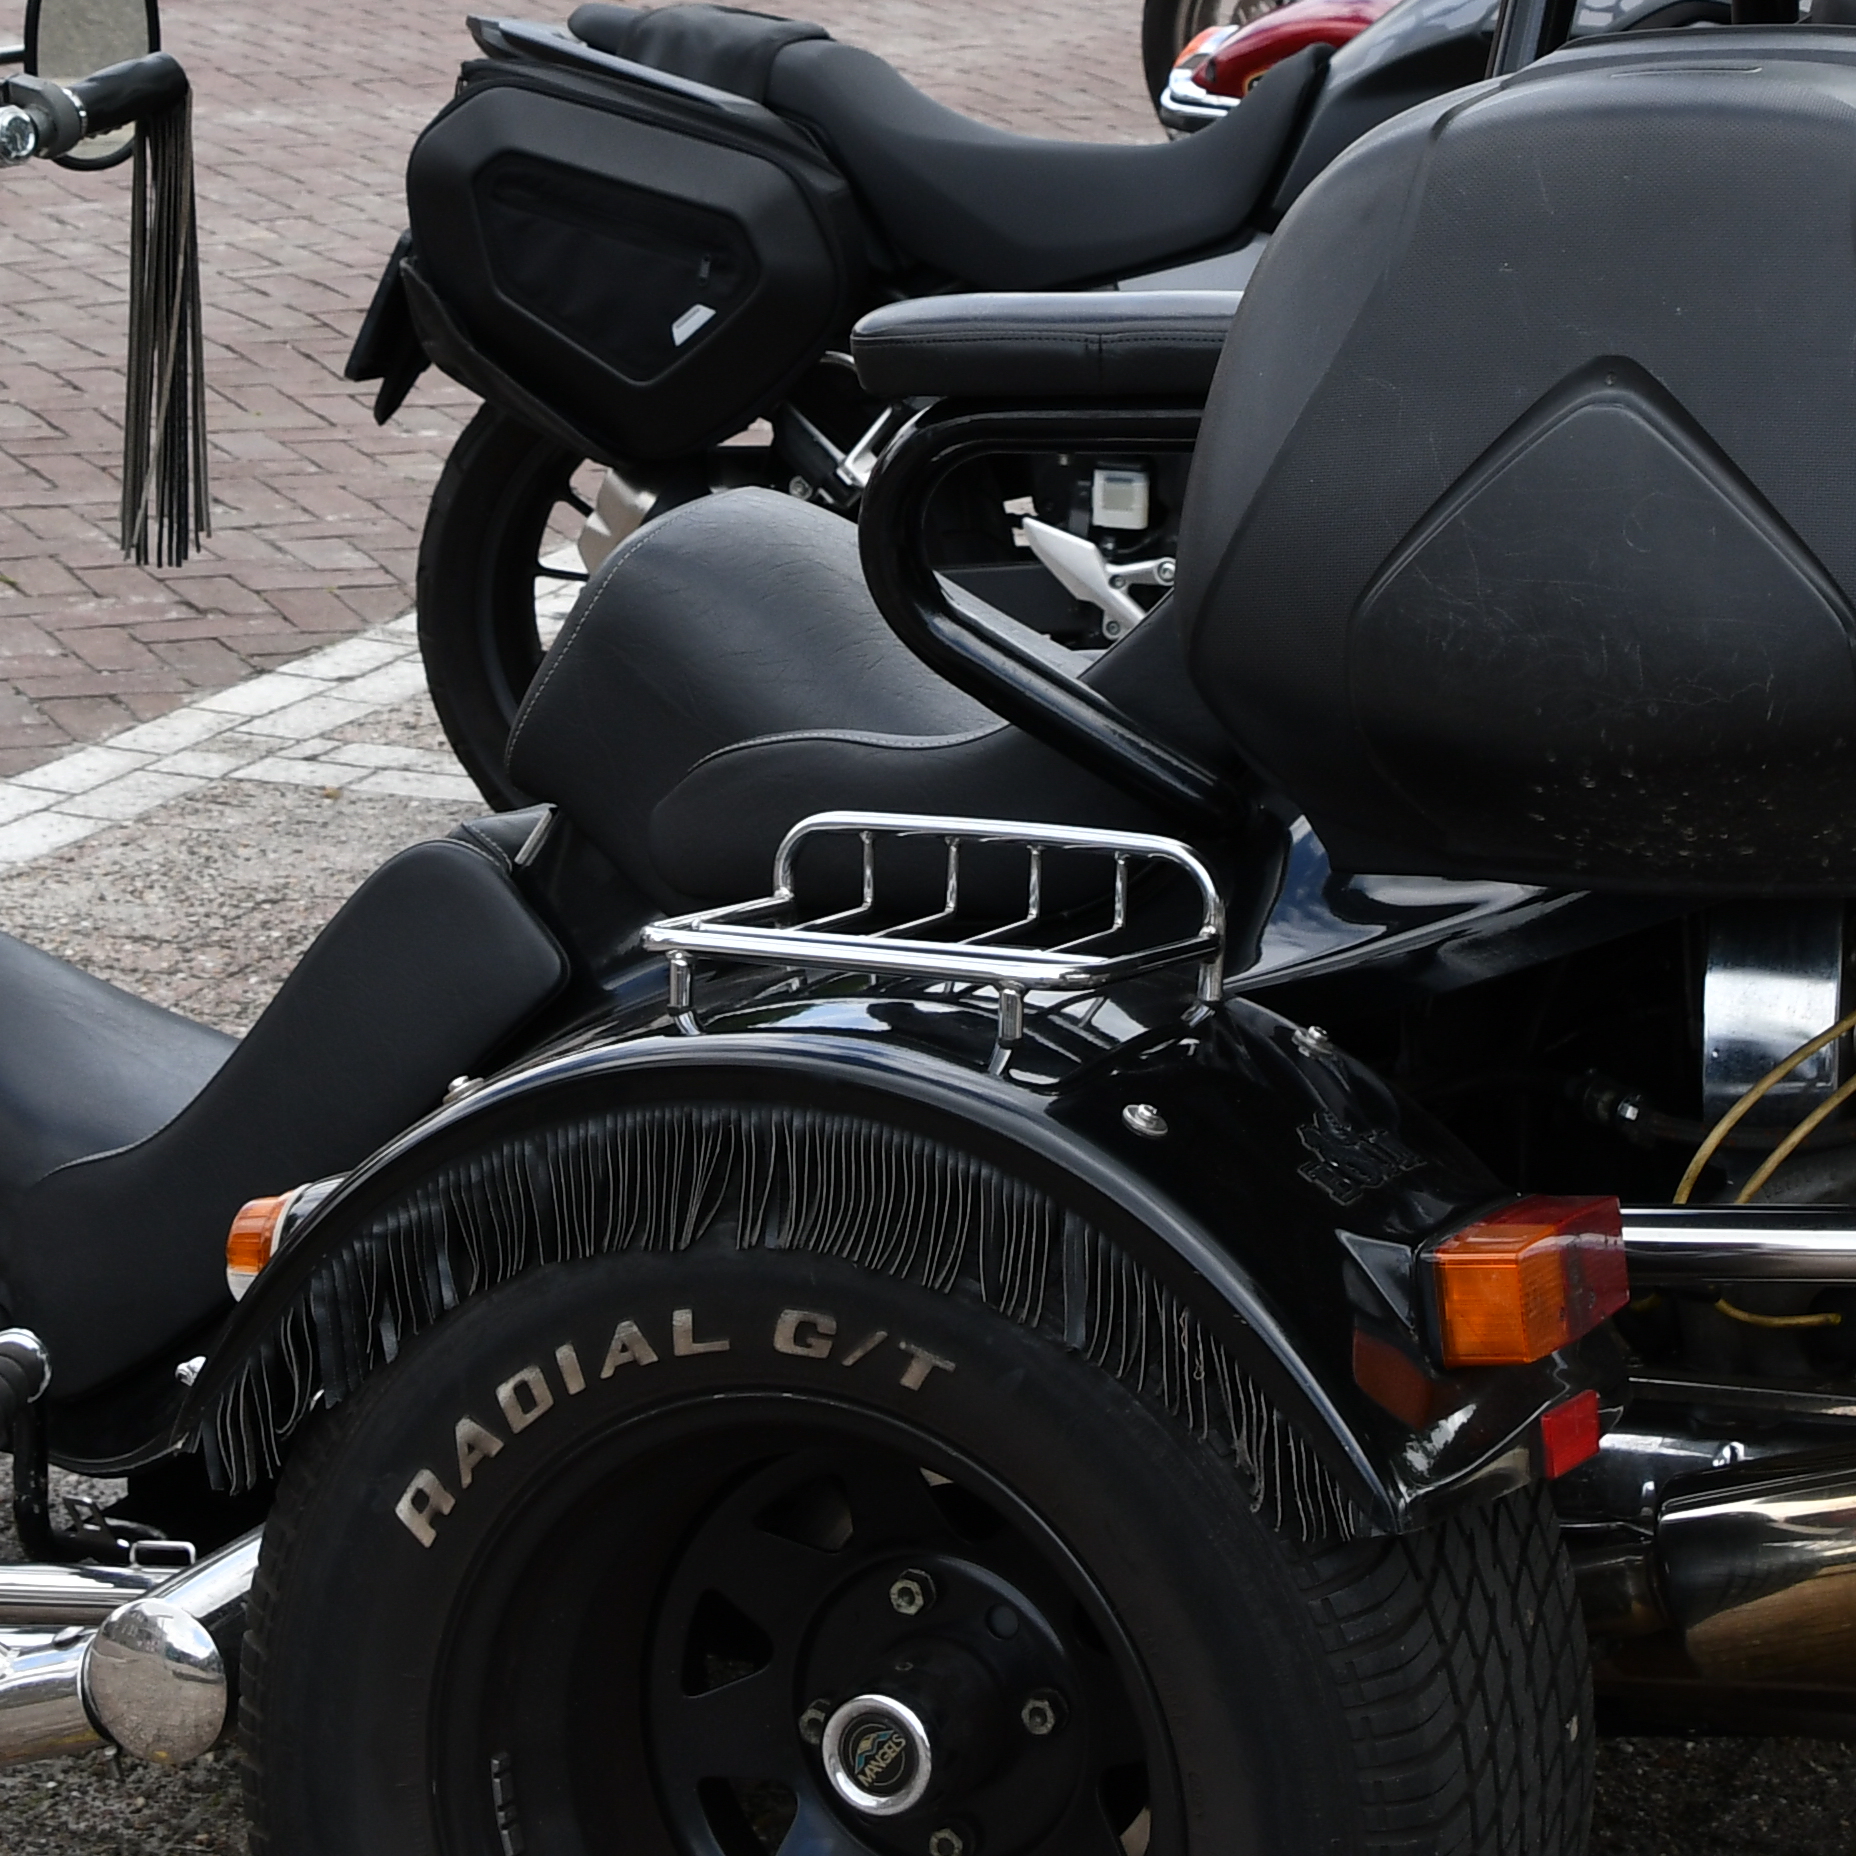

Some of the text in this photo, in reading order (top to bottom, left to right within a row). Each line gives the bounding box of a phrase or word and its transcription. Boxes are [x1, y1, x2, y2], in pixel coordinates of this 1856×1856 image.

[395, 1307, 957, 1549] RADIAL G/T
[857, 1732, 907, 1788] MANGELS
